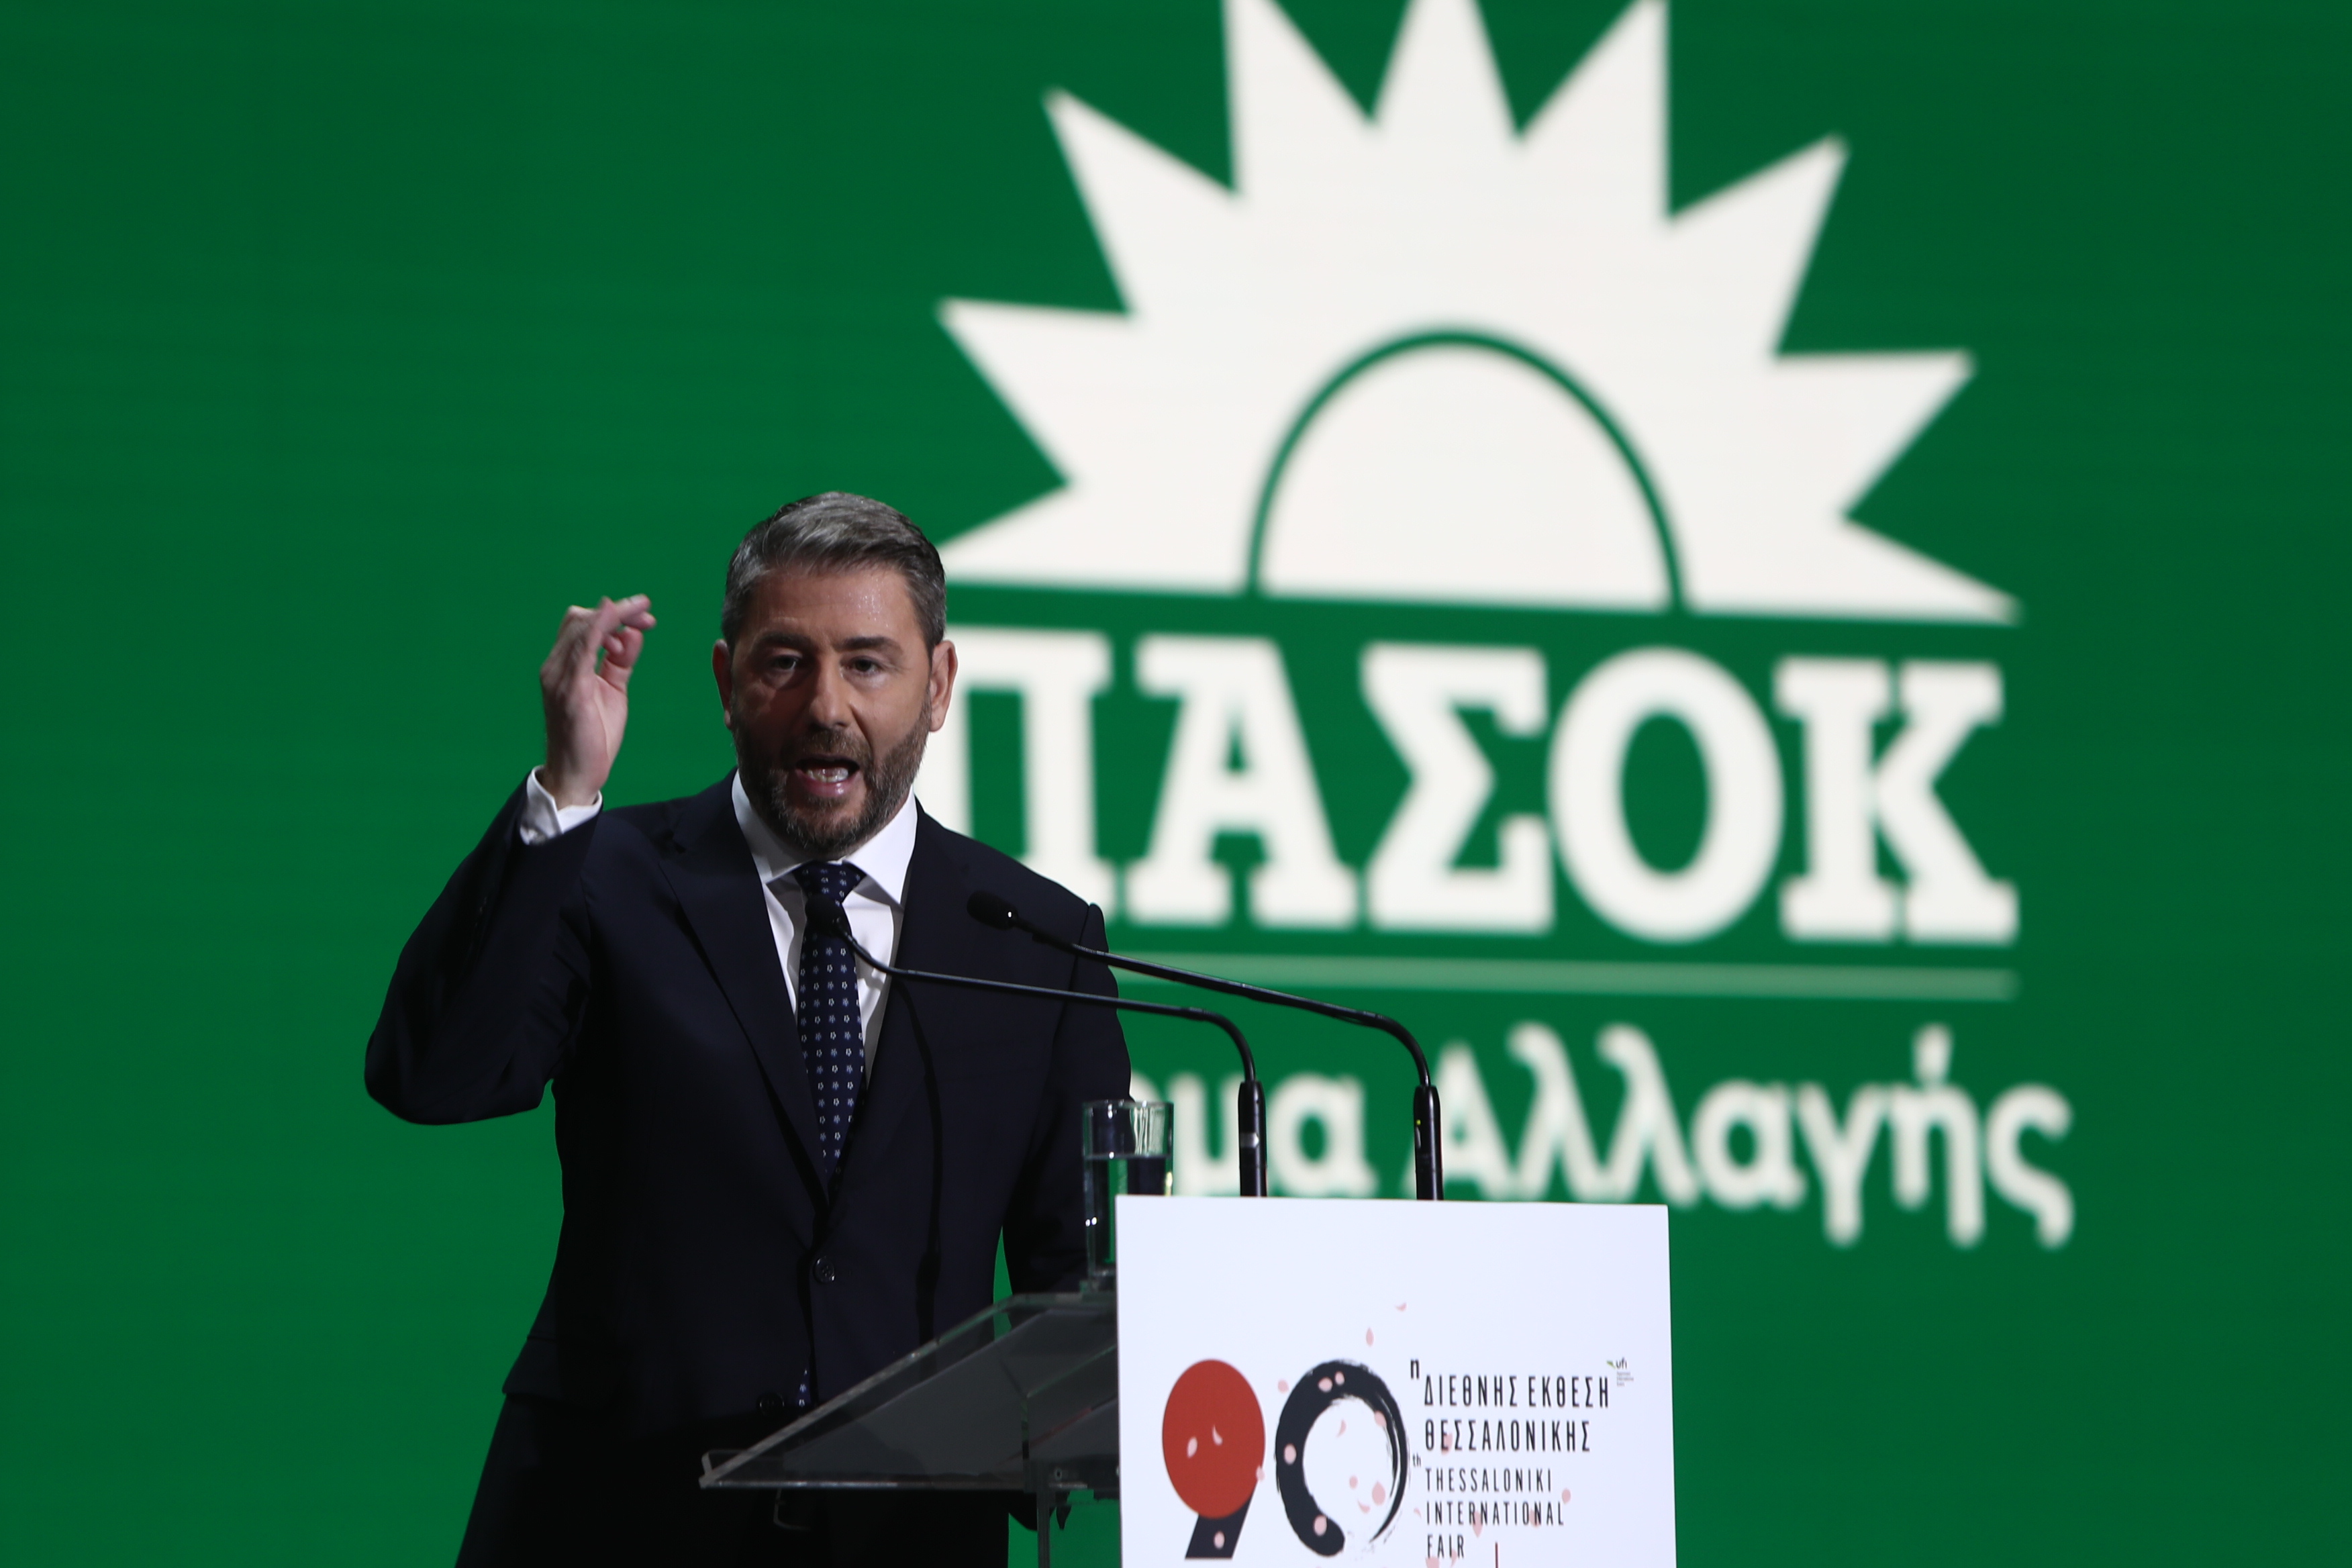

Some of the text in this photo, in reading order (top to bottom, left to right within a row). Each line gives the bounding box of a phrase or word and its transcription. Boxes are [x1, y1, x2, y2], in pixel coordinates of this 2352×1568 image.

[914, 625, 2019, 947] ΠΑΣΟΚ
[1129, 1020, 2075, 1248] μα Αλλαγής
[1424, 1374, 1518, 1407] ΔΙΕΘΝΗΣ
[1528, 1375, 1608, 1408] ΕΚΘΕΣΗ
[1425, 1419, 1590, 1452] ΘΕΣΣΑΛΟΝΙΚΗΣ
[1162, 1359, 1410, 1560] 90
[1412, 1453, 1422, 1467] th
[1425, 1467, 1552, 1493] THESSALONIKI
[1426, 1500, 1564, 1526] INTERNATIONAL
[1427, 1534, 1465, 1559] FAIR
